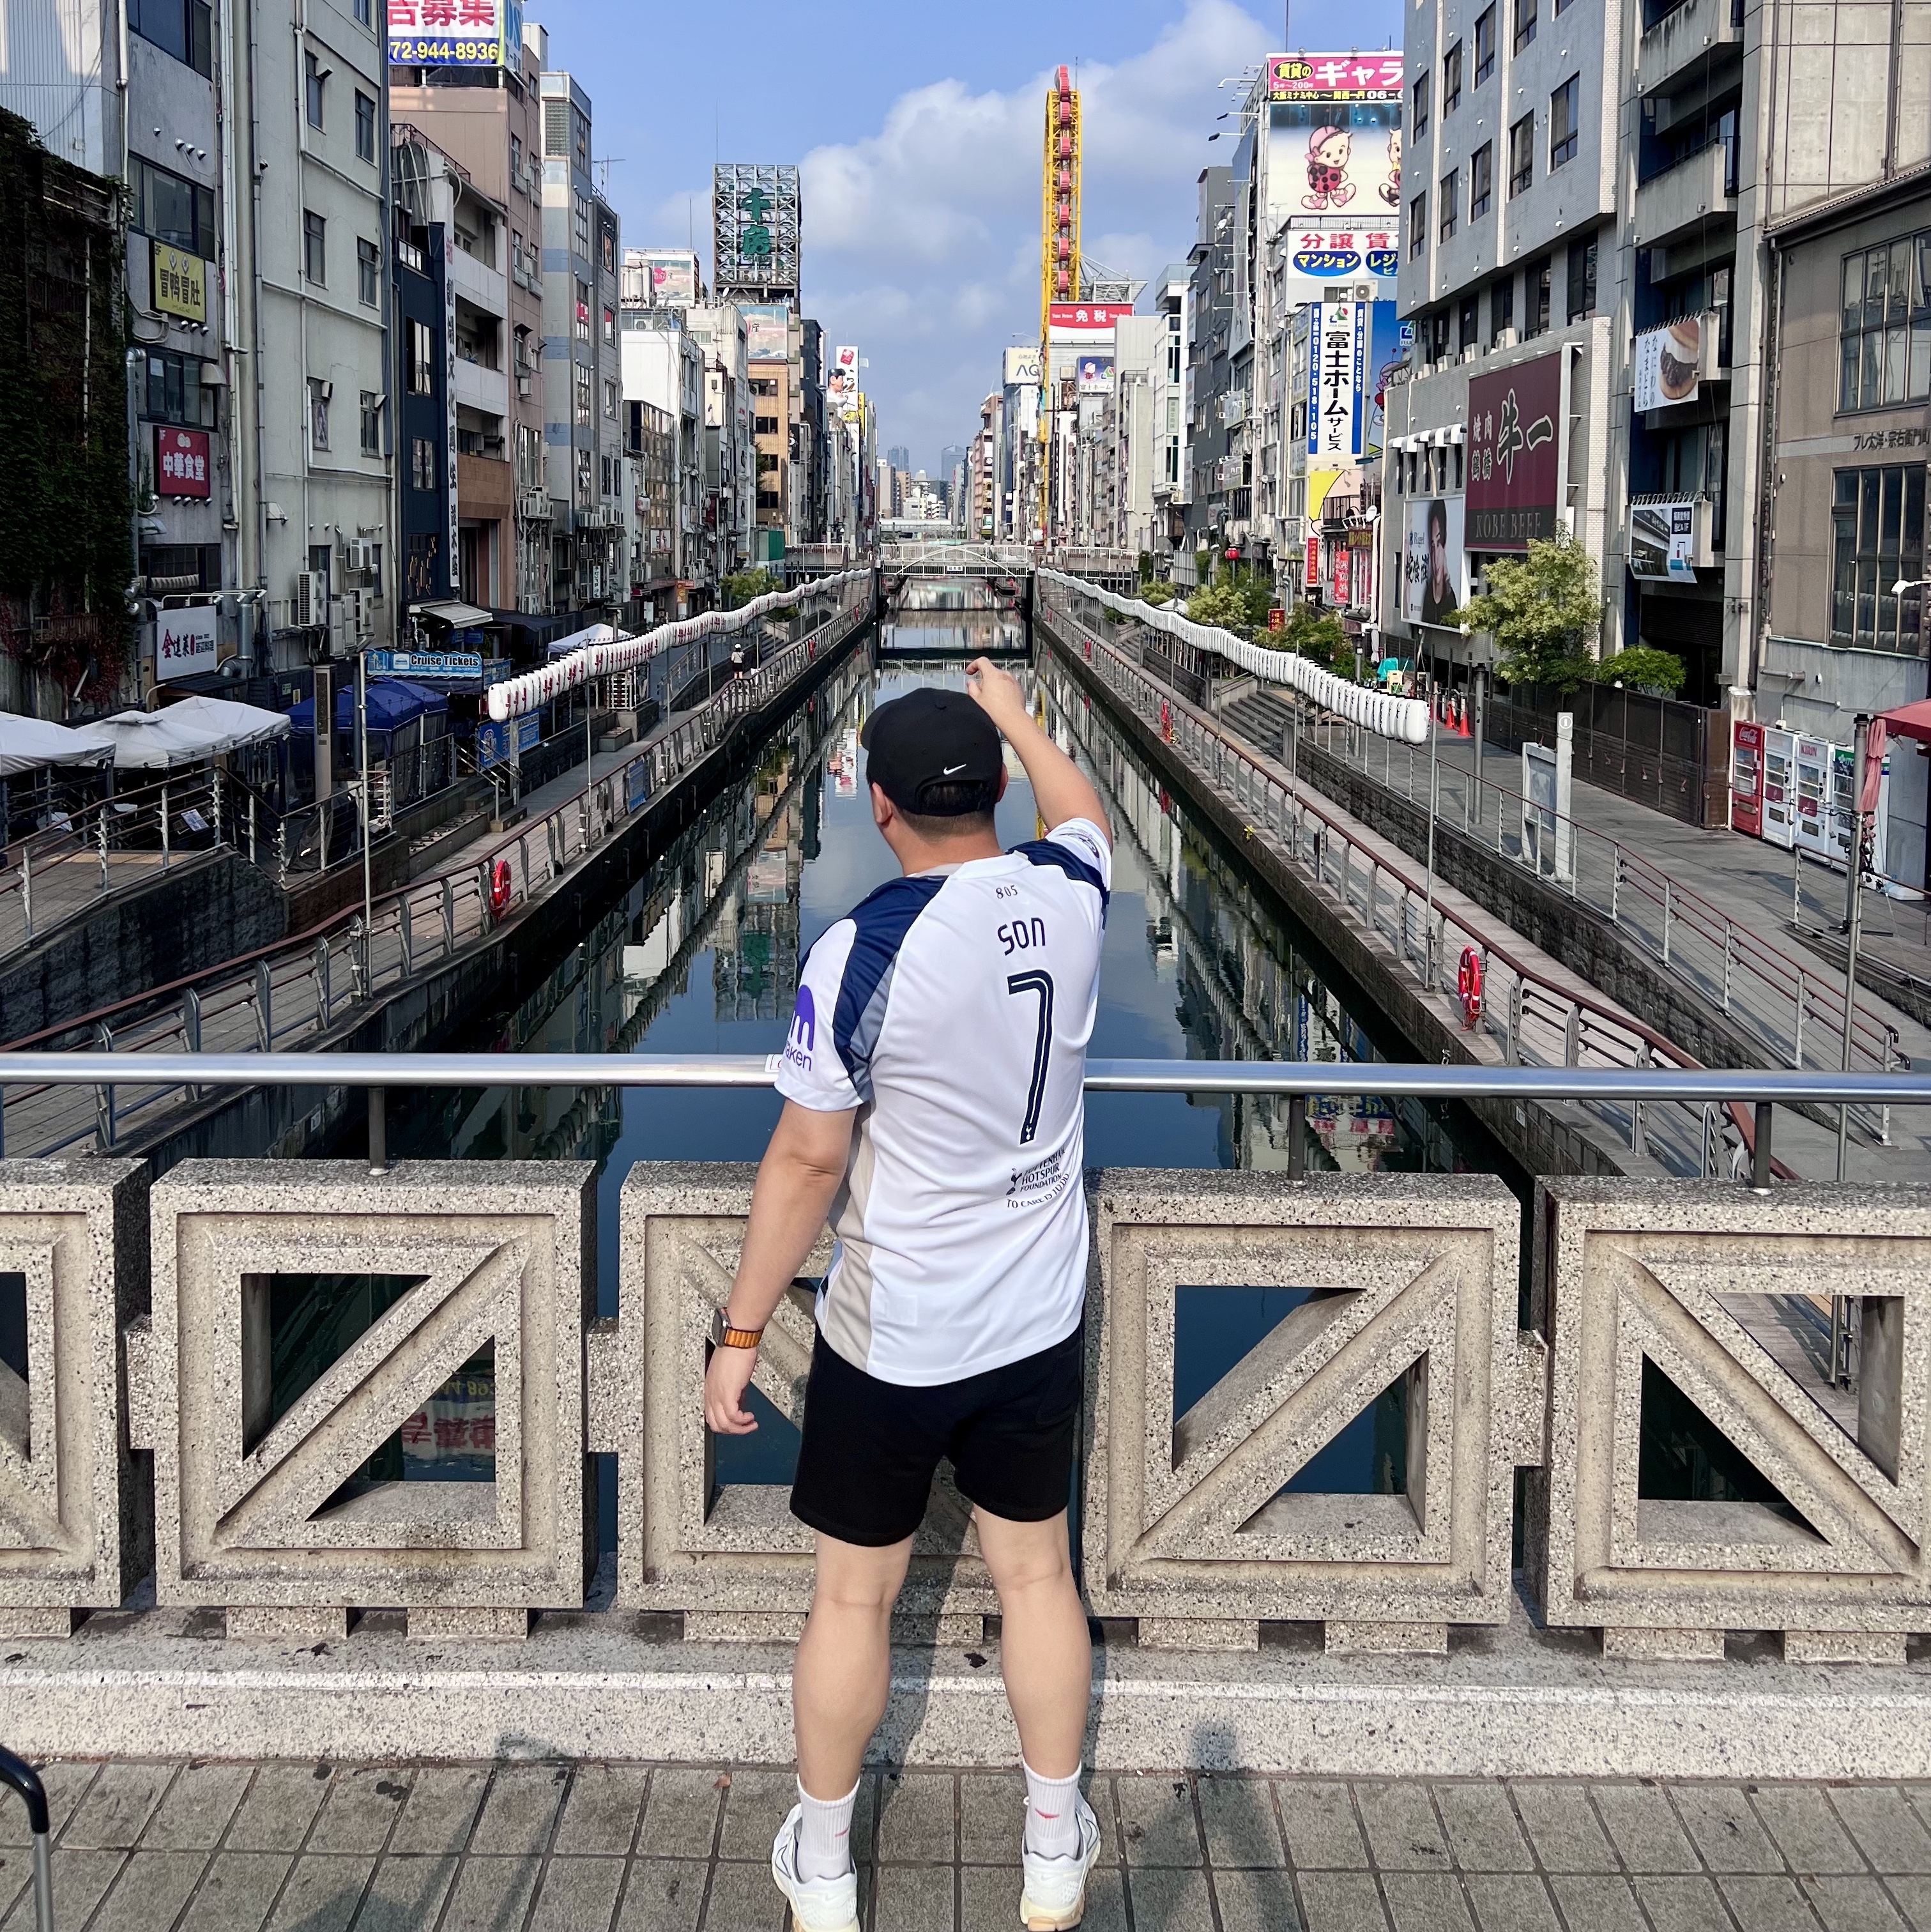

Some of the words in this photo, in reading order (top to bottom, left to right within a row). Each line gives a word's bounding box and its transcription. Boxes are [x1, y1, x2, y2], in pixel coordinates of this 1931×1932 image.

[389, 42, 498, 59] 72-944-8936
[1279, 63, 1311, 79] 賃貸の
[742, 187, 771, 255] 千房
[1301, 233, 1354, 249] 分譲
[1366, 233, 1398, 249] 賃
[1297, 254, 1359, 268] マンション
[1370, 253, 1398, 268] レジ
[1075, 309, 1106, 323] 免税
[163, 451, 204, 482] 中華食堂
[1475, 513, 1506, 539] KOBE
[1510, 512, 1541, 539] BEEF
[410, 655, 442, 665] Cruise
[443, 655, 478, 666] Tickets
[1800, 744, 1817, 757] KIRIN
[995, 884, 1018, 900] 805
[1007, 968, 1055, 1146] 7
[1022, 1162, 1060, 1186] HOTSPUR
[1019, 1173, 1062, 1192] FOUNDATION
[1007, 1198, 1018, 1209] TO
[1021, 1197, 1044, 1208] CARE
